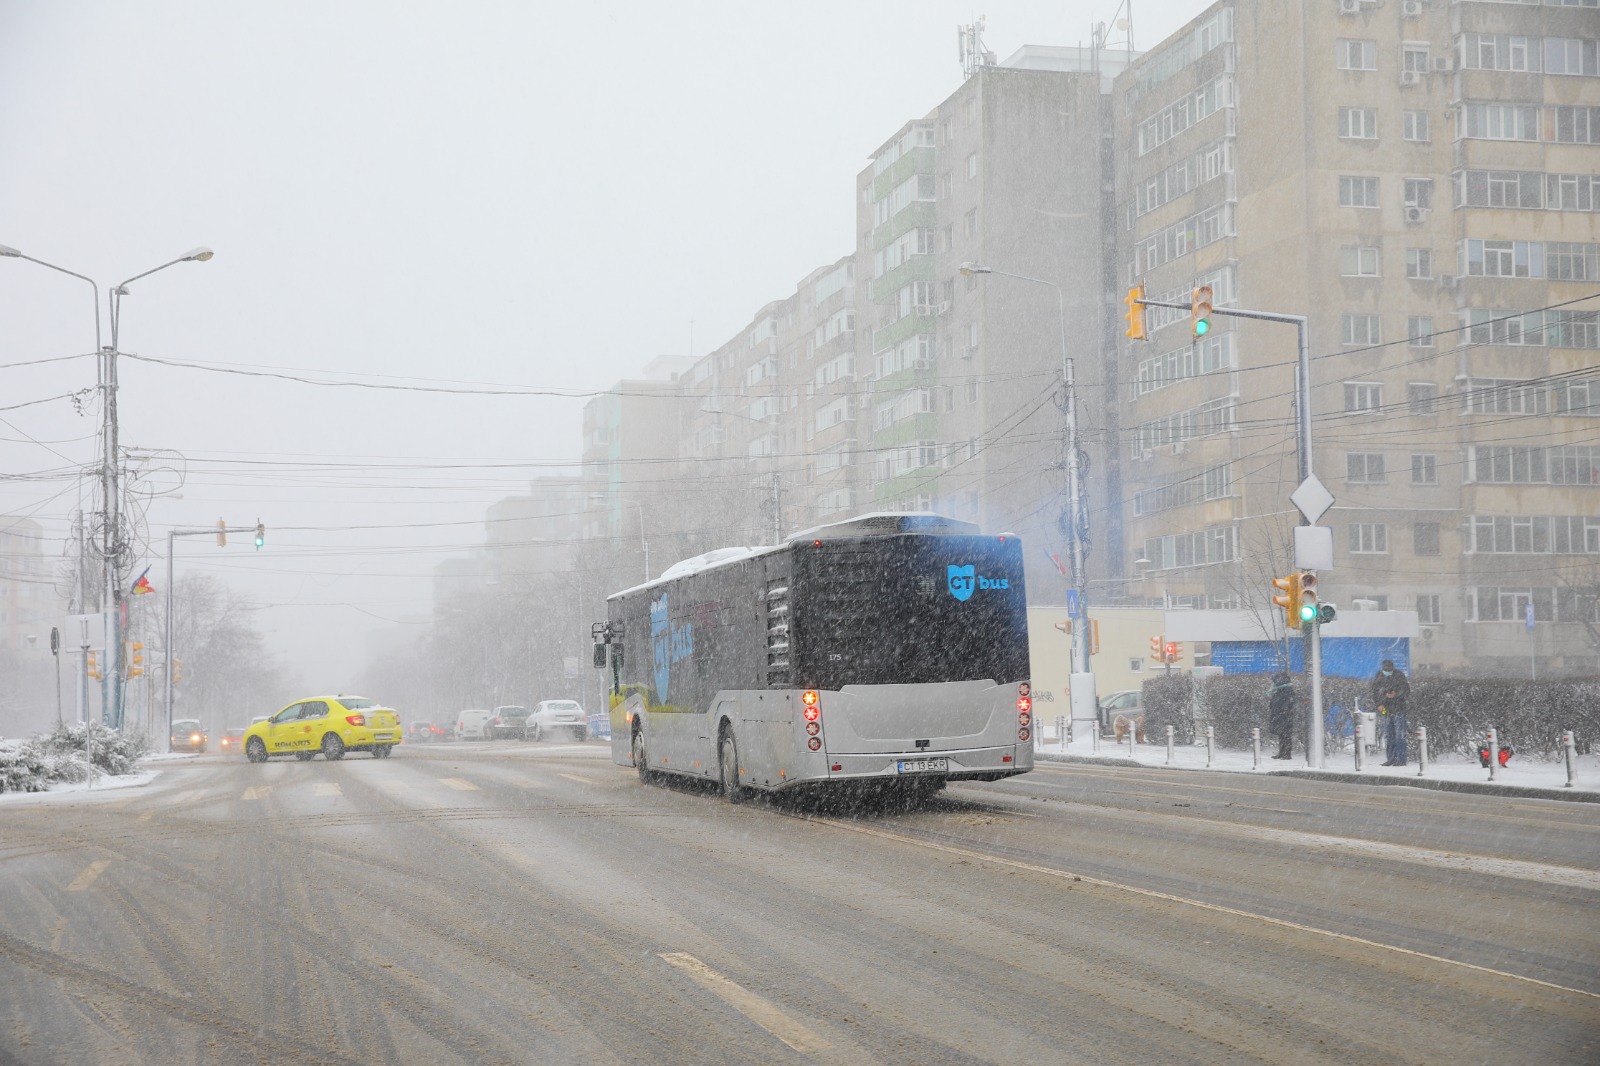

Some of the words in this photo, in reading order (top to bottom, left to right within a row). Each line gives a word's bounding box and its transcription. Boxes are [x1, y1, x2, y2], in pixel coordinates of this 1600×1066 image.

[950, 576, 973, 590] CT
[978, 575, 1009, 590] bus
[671, 621, 693, 664] bus
[829, 653, 842, 661] 175
[903, 762, 915, 771] CT
[917, 761, 926, 770] 13
[927, 760, 946, 770] EKR
